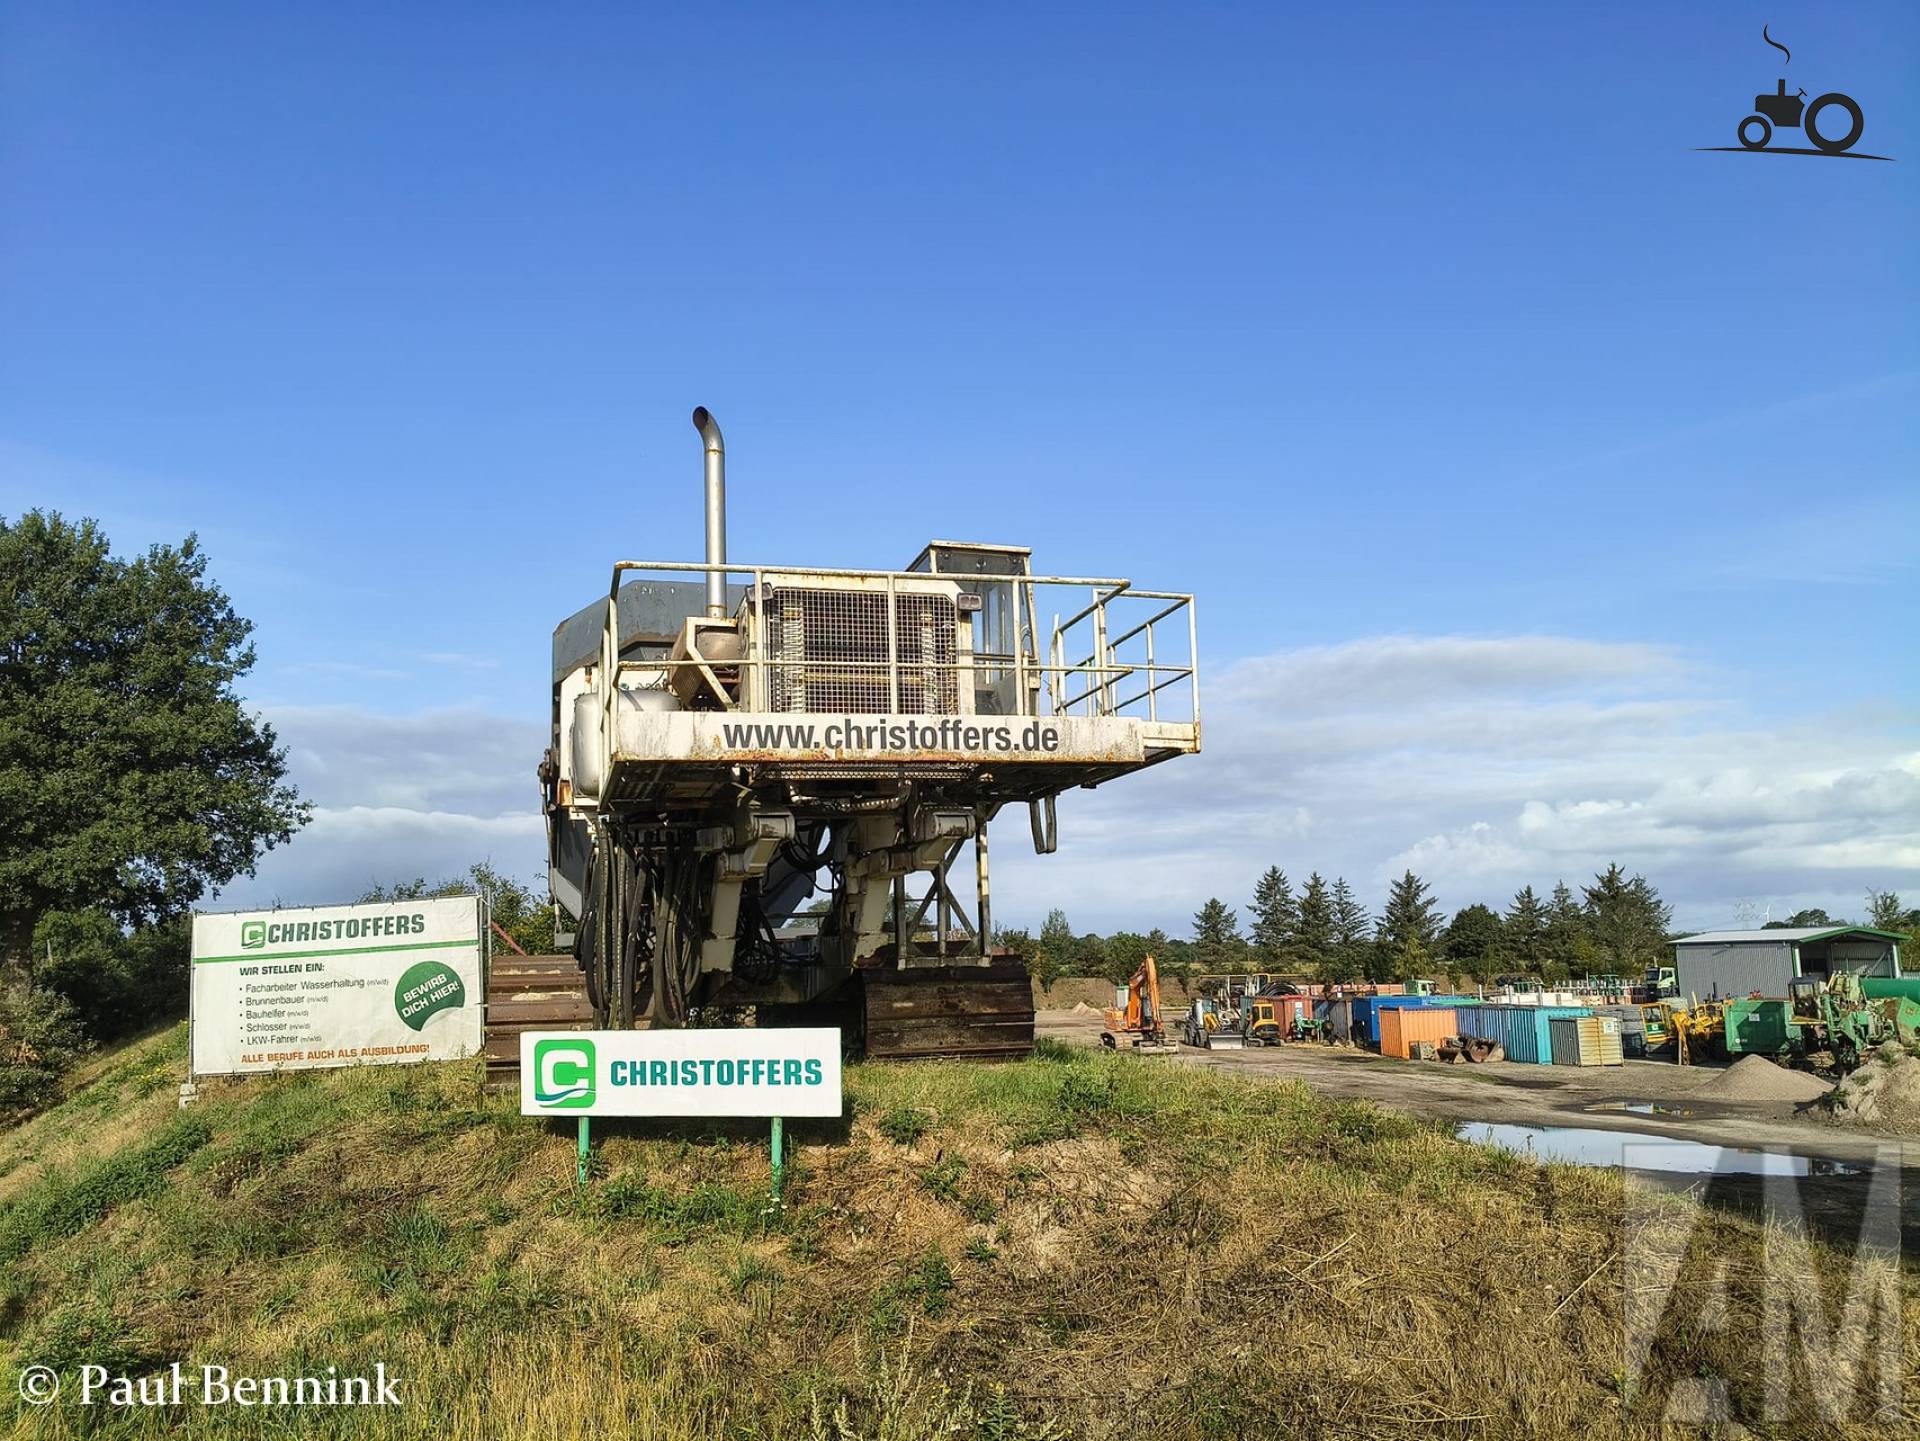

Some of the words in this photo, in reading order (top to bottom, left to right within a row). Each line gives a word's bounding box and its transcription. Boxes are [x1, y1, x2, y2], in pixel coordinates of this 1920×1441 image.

[723, 719, 1059, 751] www.christoffers.de
[268, 914, 424, 943] CHRISTOFFERS
[239, 966, 259, 976] WIR
[262, 964, 302, 975] STELLEN
[305, 963, 325, 973] EIN:
[245, 983, 297, 993] Facharbeiter
[300, 978, 365, 990] Wasserhaltung
[403, 974, 447, 1002] BEWIRB
[246, 996, 305, 1006] Brunnenbauer
[401, 997, 429, 1019] DICH
[430, 981, 460, 1003] HIER!
[246, 1008, 285, 1019] Bauhelfer
[246, 1022, 287, 1032] Schlosser
[247, 1035, 298, 1045] LKW-Fahrer
[241, 1054, 263, 1063] ALLE
[268, 1052, 304, 1062] BERUFE
[307, 1050, 335, 1060] AUCH
[338, 1049, 357, 1058] ALS
[360, 1044, 430, 1057] AUSBILDUNG!
[610, 1058, 823, 1087] CHRISTOFFERS
